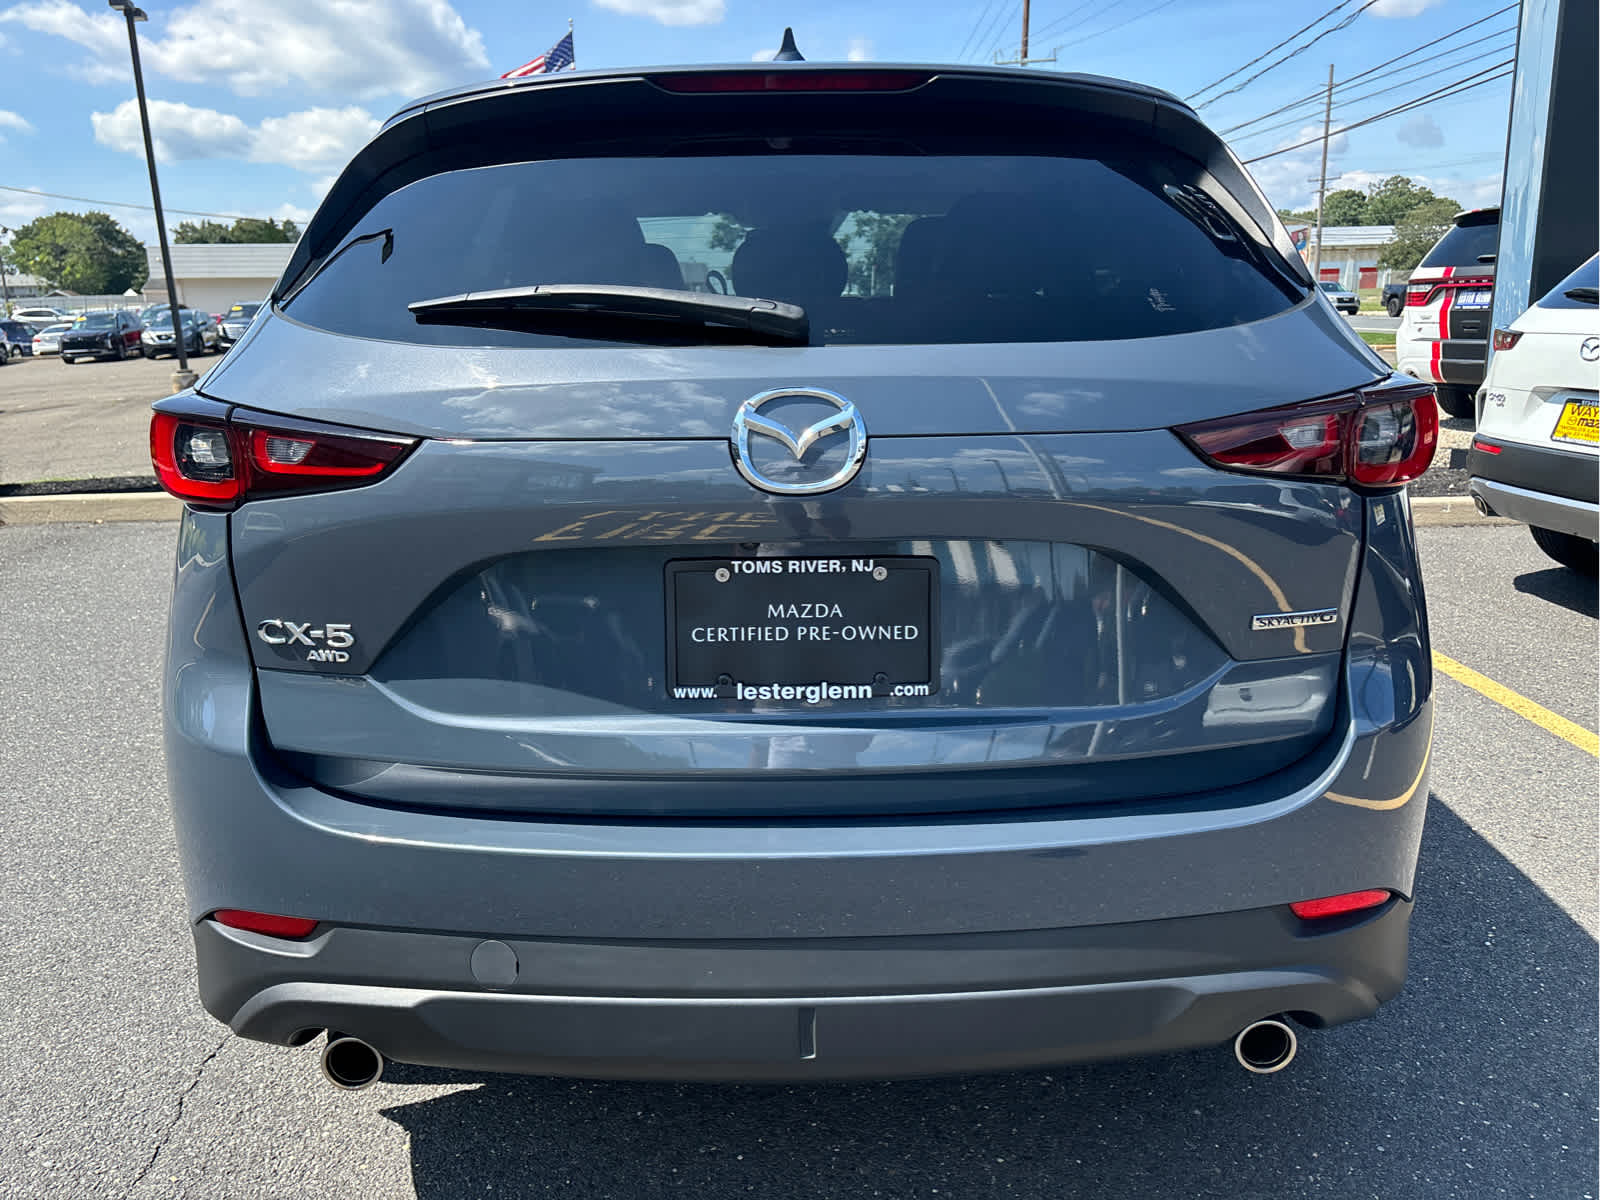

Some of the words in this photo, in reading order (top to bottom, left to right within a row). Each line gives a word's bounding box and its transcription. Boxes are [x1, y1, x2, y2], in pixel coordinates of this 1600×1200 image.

[731, 560, 783, 574] TOMS
[788, 560, 847, 573] RIVER,
[851, 559, 874, 572] NJ
[767, 603, 844, 619] MAZDA
[257, 618, 355, 648] CX-5
[691, 627, 789, 642] CERTIFIED
[797, 625, 919, 641] PRE-OWNED
[306, 649, 350, 662] AWD
[673, 687, 718, 699] www.
[736, 682, 873, 703] lesterglenn
[889, 684, 930, 697] .com
